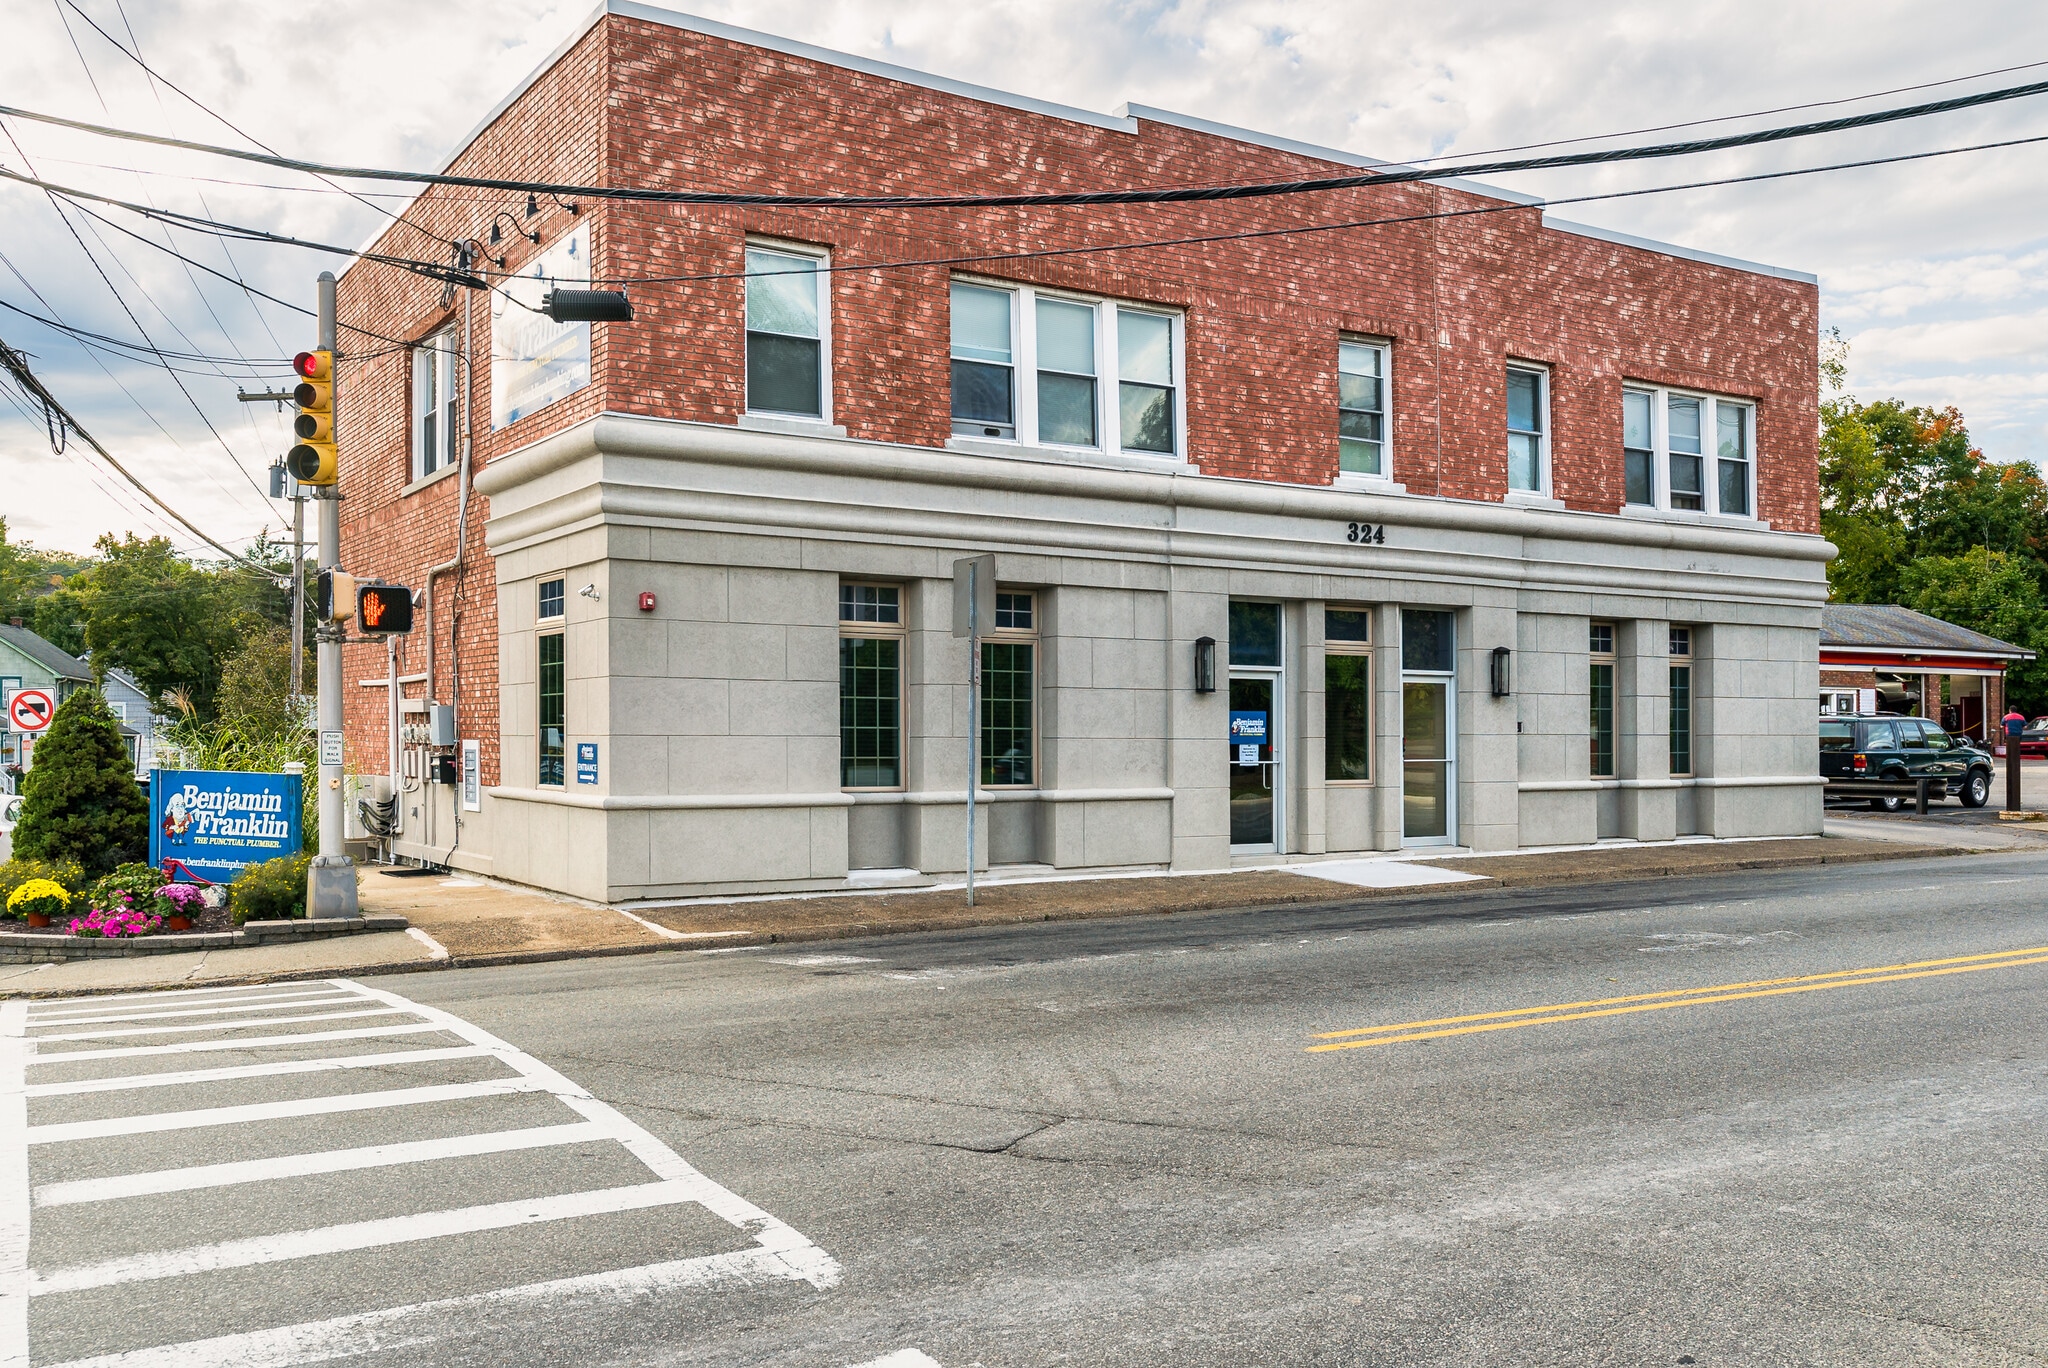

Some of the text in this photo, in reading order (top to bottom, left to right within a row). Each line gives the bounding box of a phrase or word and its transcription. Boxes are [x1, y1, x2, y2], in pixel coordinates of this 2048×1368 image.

[1347, 522, 1385, 544] 324
[1236, 718, 1263, 727] Benjamin
[1239, 725, 1265, 733] Franklin
[577, 763, 598, 772] ENTRANCE
[183, 785, 282, 816] Benjamin
[196, 811, 288, 838] Franklin
[194, 837, 208, 845] THE
[209, 837, 245, 847] PUNCTUAL
